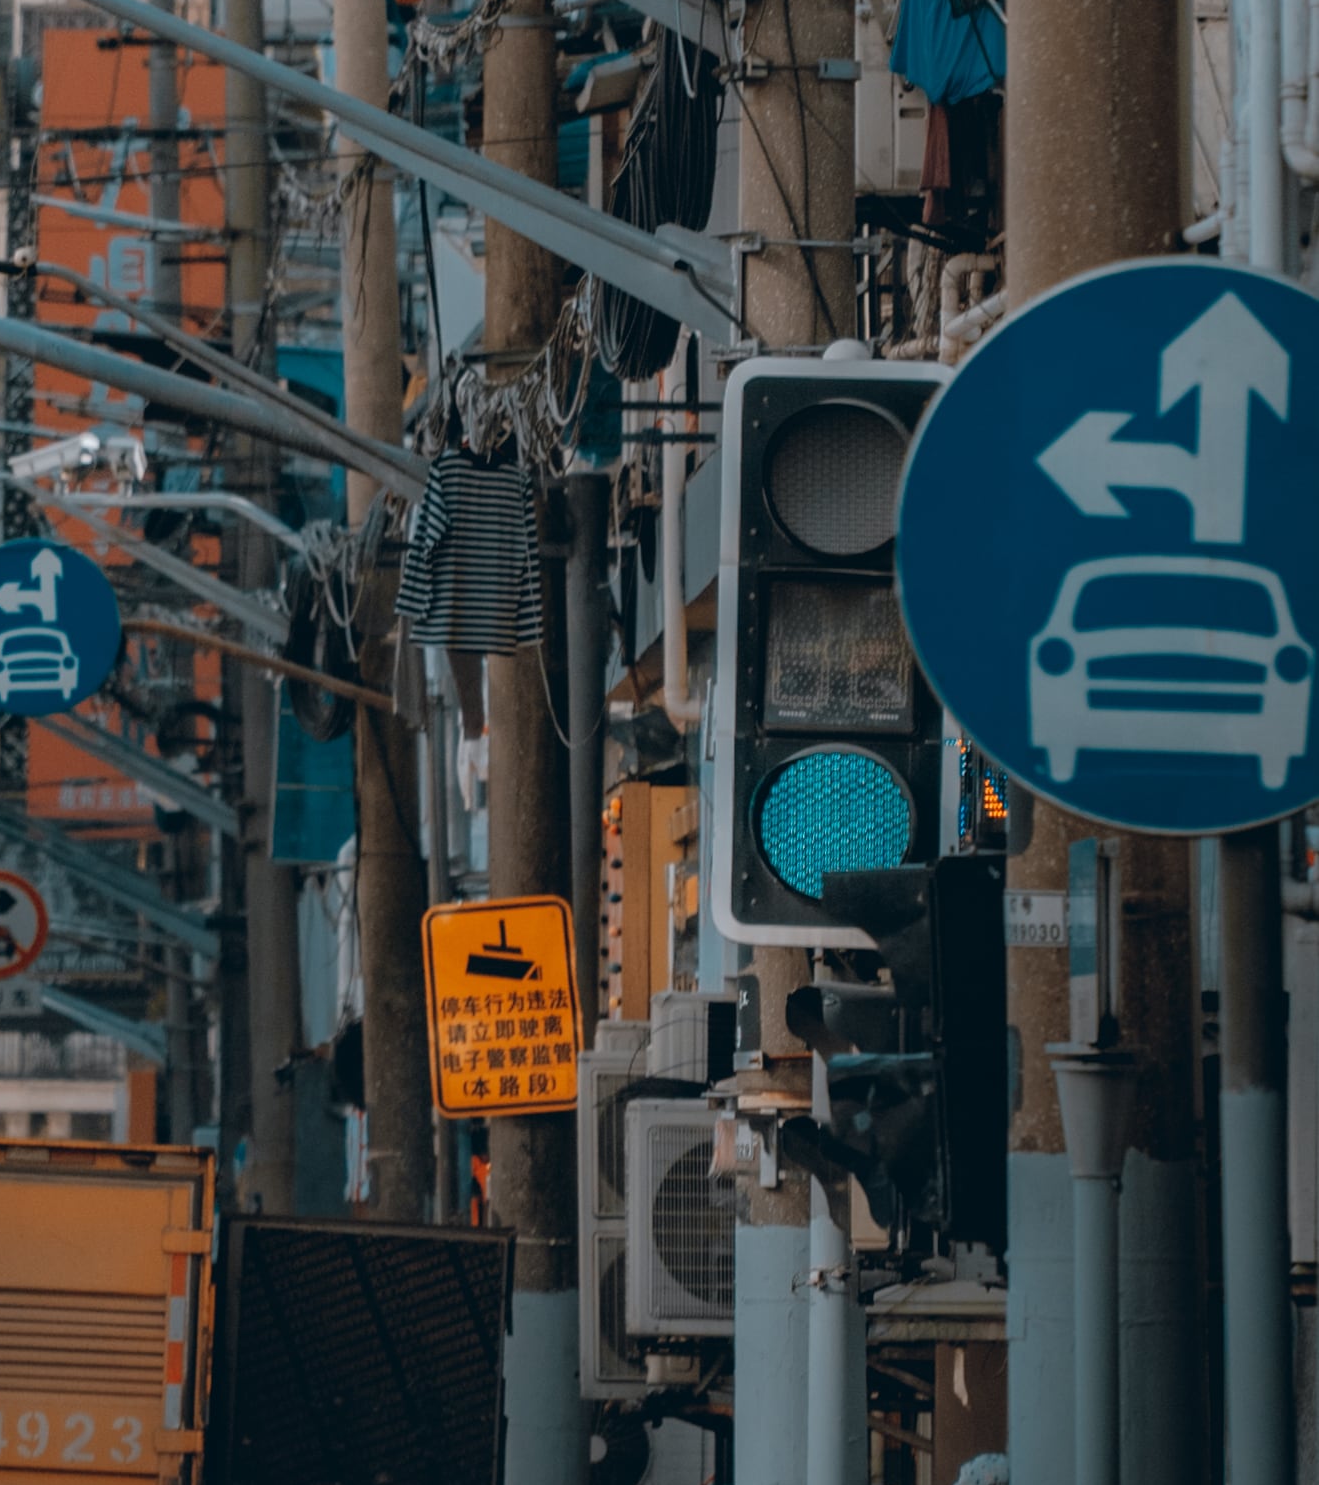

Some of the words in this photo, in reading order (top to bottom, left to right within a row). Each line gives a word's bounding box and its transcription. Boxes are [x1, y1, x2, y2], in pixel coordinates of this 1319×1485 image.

[441, 988, 569, 1019] 停车行为违法
[448, 1015, 563, 1045] 请立即驶离
[443, 1042, 573, 1074] 电子警察监管
